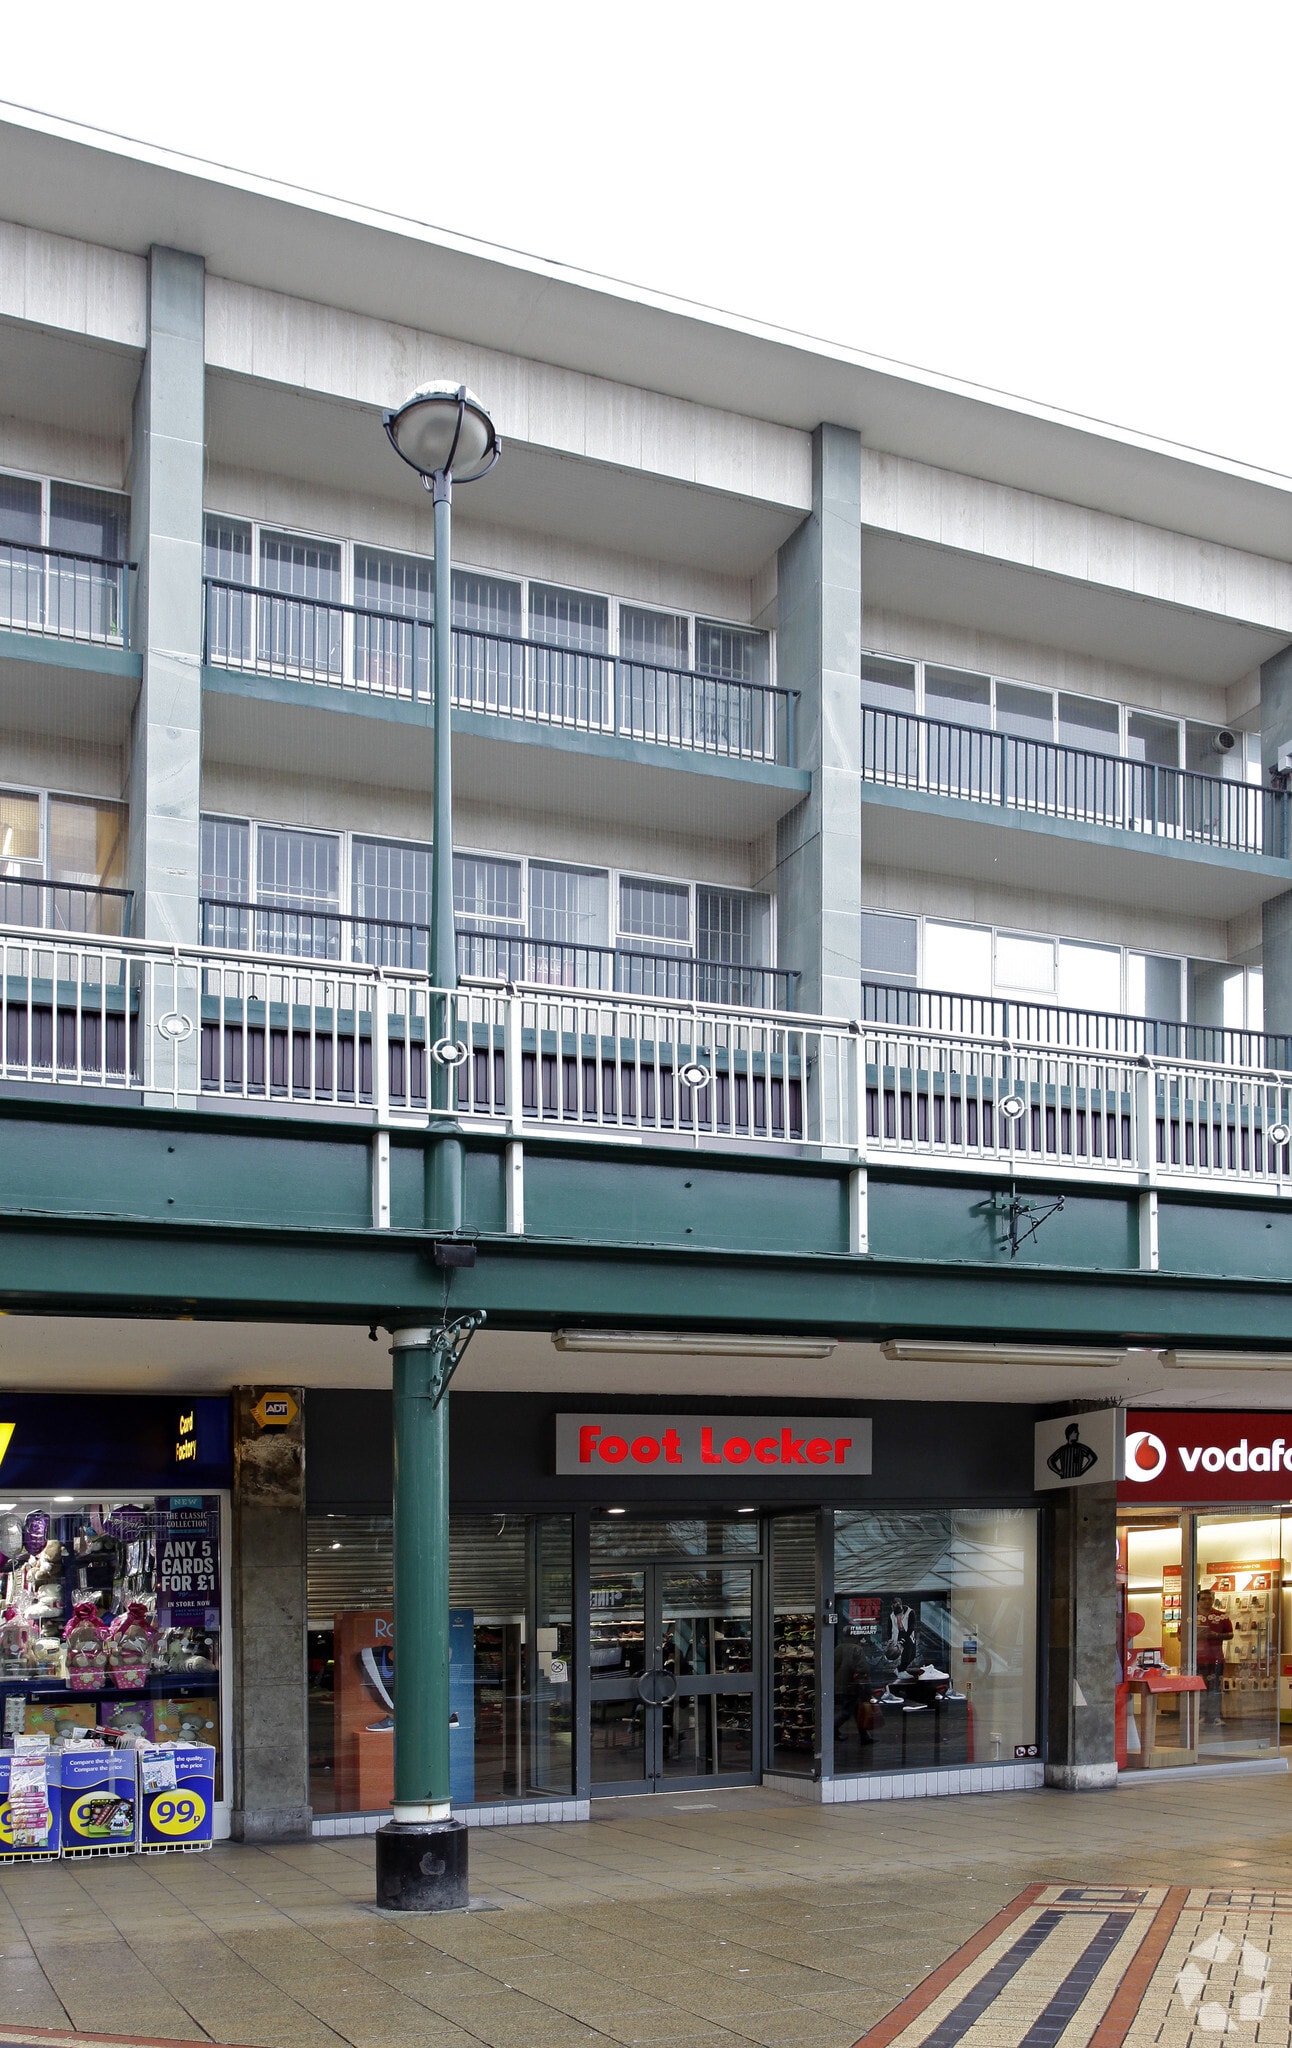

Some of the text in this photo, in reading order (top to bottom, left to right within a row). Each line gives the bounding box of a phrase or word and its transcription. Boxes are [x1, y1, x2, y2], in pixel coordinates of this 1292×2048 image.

[266, 1404, 287, 1412] ADT
[180, 1410, 194, 1435] Card
[176, 1439, 197, 1462] Factory
[578, 1424, 853, 1465] Foot Locker
[166, 1520, 208, 1528] COLLECTION
[164, 1540, 212, 1558] ANY 5
[161, 1557, 214, 1575] CARDS
[161, 1574, 215, 1592] FOR £1
[849, 1605, 880, 1616] HEAT
